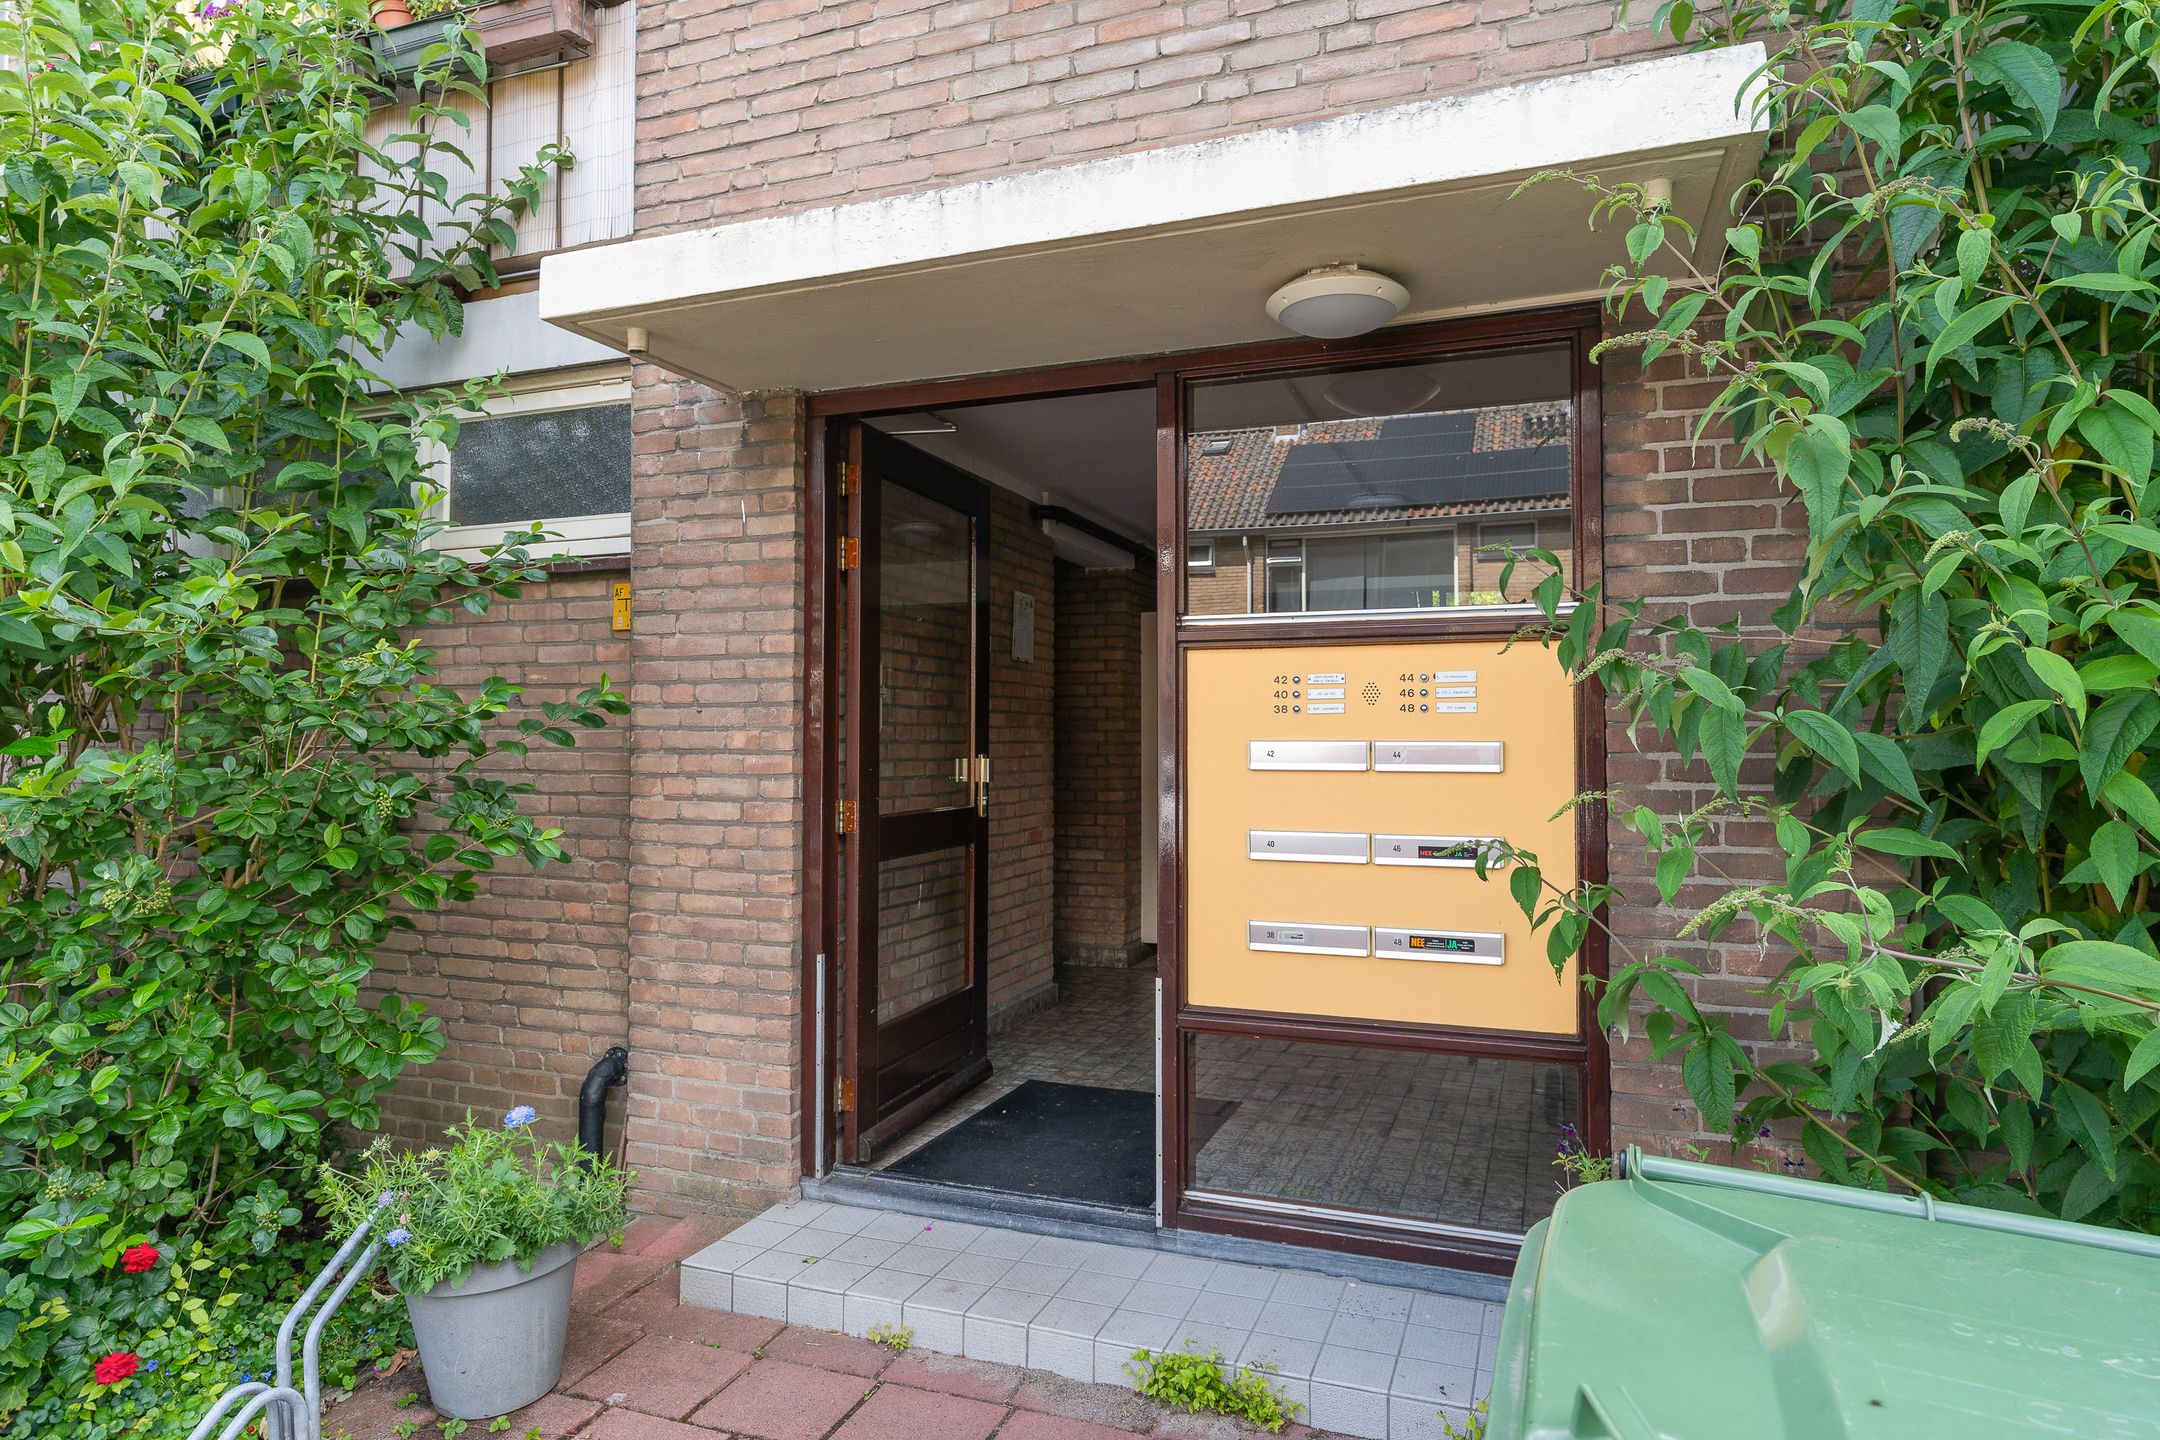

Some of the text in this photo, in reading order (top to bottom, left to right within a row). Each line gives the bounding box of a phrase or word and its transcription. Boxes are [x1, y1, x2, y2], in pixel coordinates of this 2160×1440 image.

[615, 588, 624, 597] AF
[1273, 676, 1288, 685] 42
[1399, 673, 1414, 683] 44
[1273, 690, 1288, 699] 40
[1399, 688, 1414, 698] 46
[1273, 705, 1288, 714] 38
[1399, 703, 1414, 713] 48
[1266, 750, 1275, 758] 42
[1392, 751, 1401, 759] 44
[1266, 840, 1275, 848] 40
[1266, 931, 1275, 939] 38
[1393, 938, 1402, 946] 48
[1410, 937, 1425, 948] NEE
[1447, 940, 1458, 949] JA
